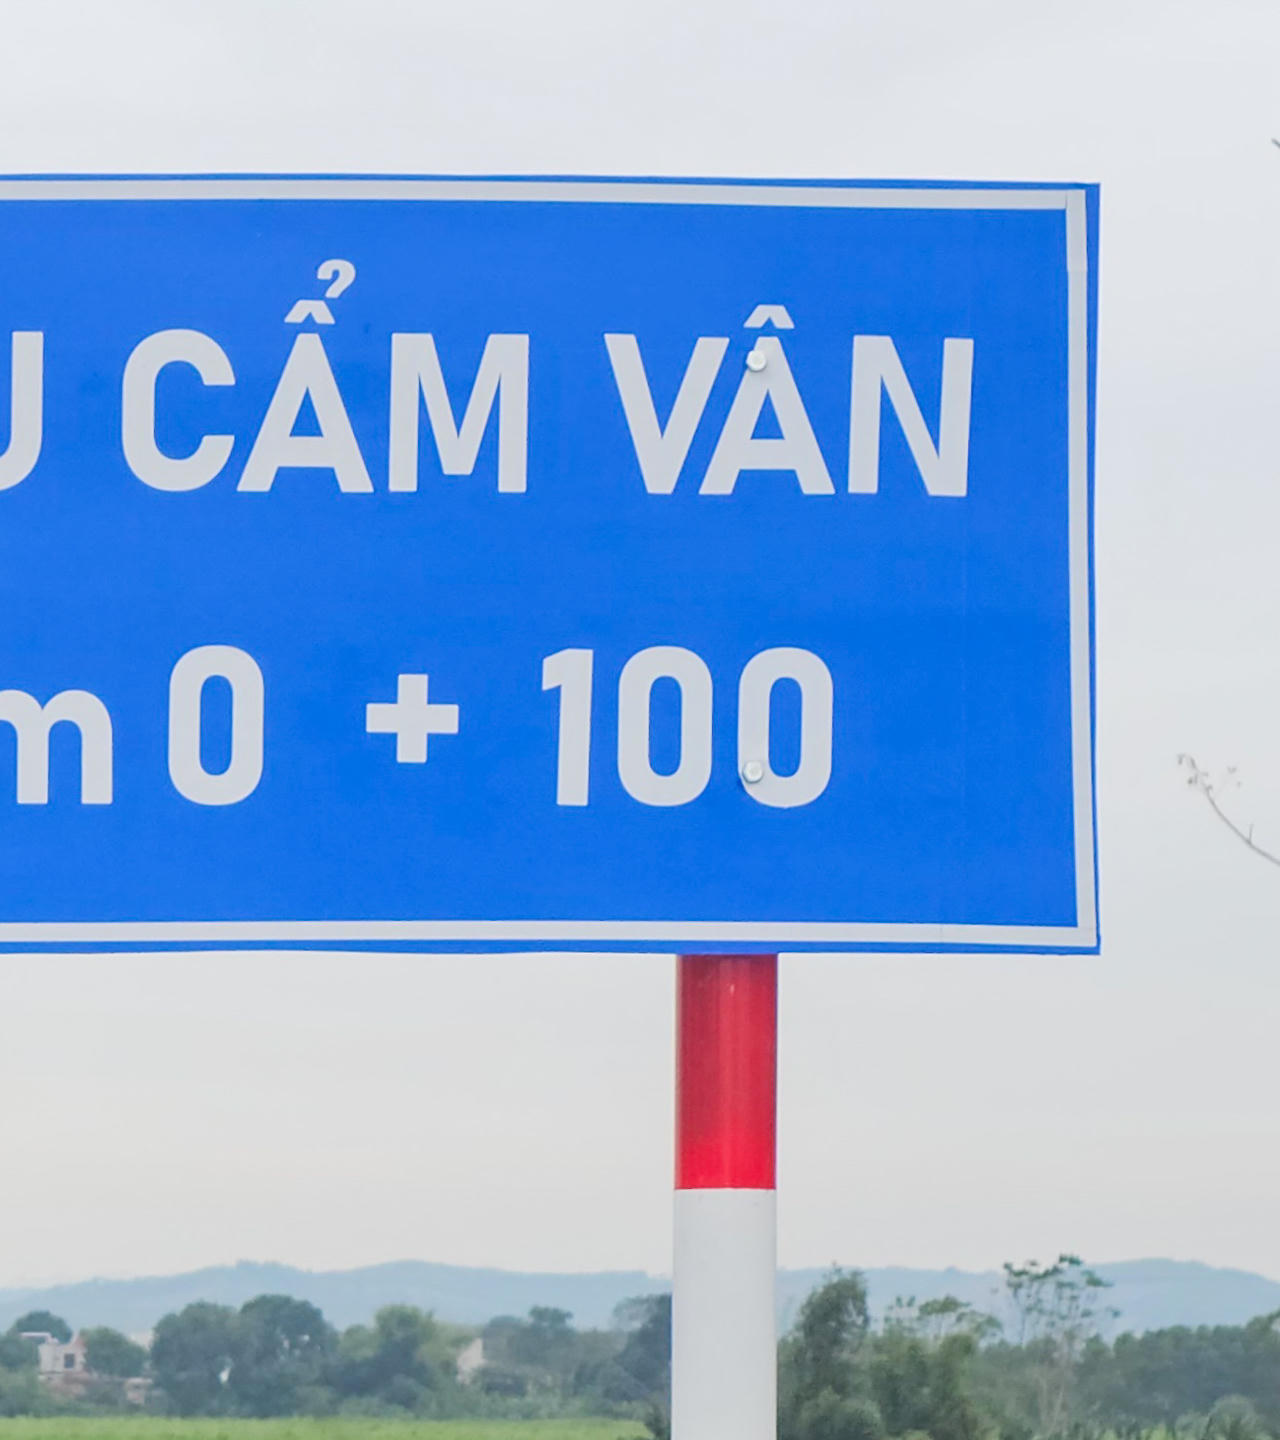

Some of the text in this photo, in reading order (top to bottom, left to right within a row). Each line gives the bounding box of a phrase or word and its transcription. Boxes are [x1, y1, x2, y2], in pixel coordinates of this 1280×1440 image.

[121, 259, 531, 493] CẨM
[603, 304, 975, 498] VÂN
[167, 645, 266, 806] 0
[365, 673, 460, 764] +
[541, 647, 835, 808] 100
